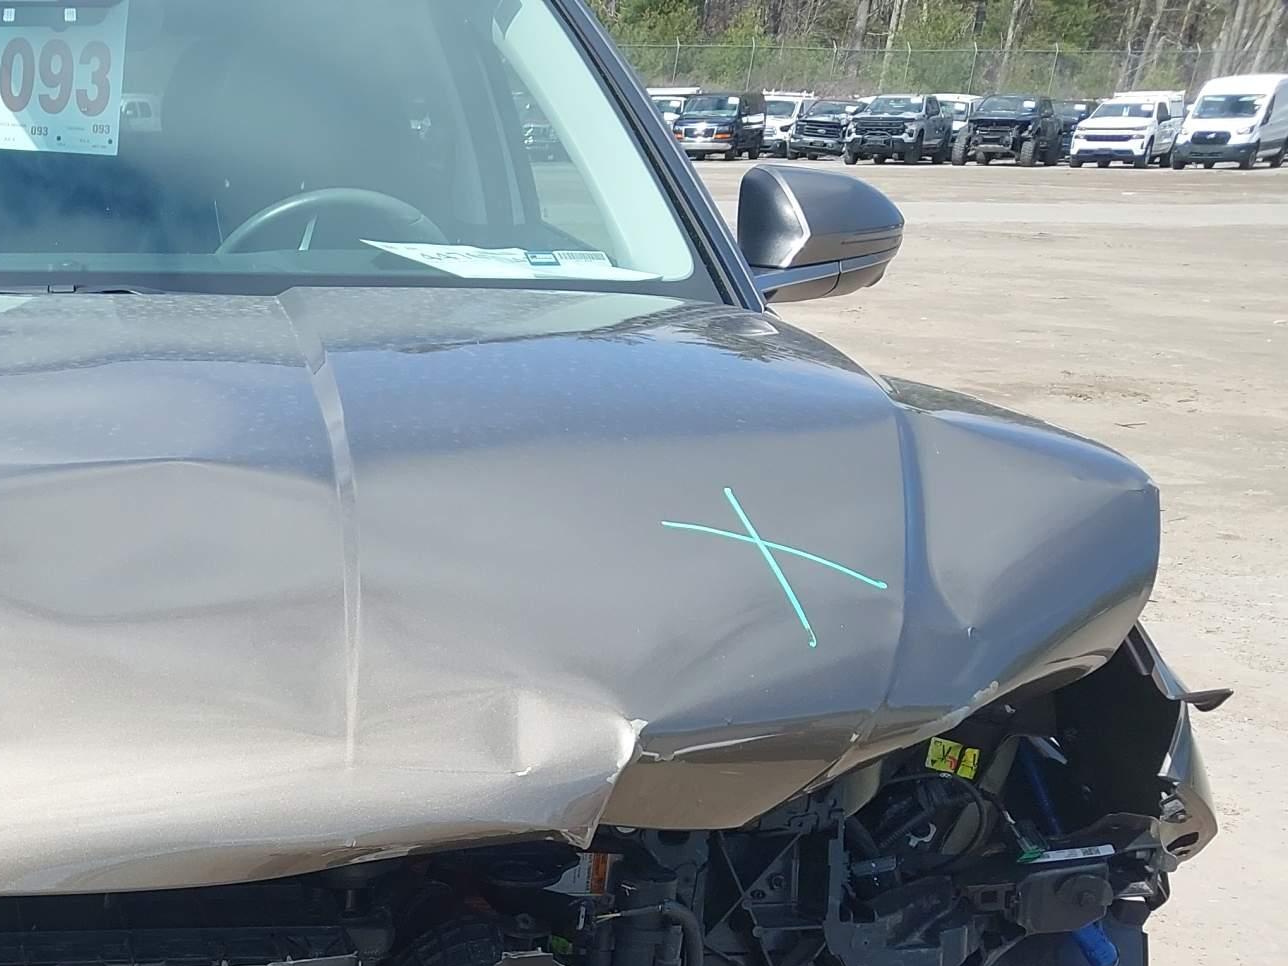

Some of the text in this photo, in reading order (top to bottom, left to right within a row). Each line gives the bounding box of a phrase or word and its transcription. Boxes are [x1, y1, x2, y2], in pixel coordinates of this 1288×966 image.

[0, 37, 112, 117] 093
[31, 126, 49, 136] 093
[92, 124, 110, 134] 093
